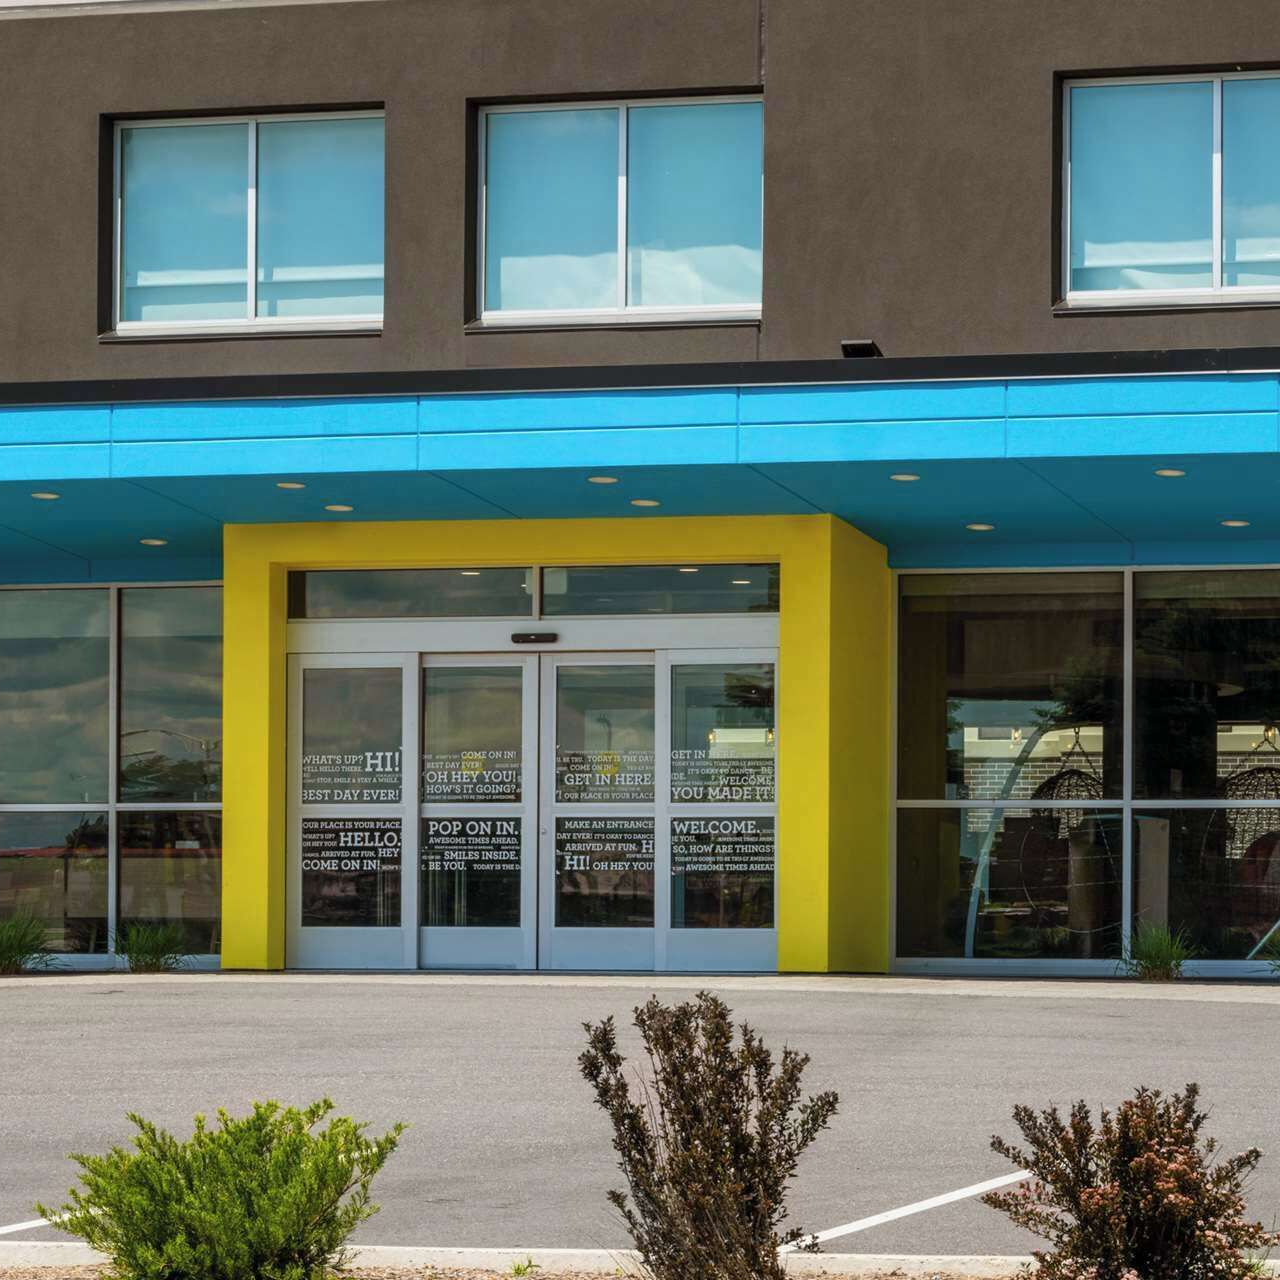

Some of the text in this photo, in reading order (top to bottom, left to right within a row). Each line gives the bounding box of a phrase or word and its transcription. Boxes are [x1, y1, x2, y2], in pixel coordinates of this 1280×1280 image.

[344, 755, 363, 764] UP?
[672, 751, 692, 759] GET
[695, 751, 705, 759] IN
[365, 752, 399, 771] HI!
[427, 771, 448, 782] OH
[452, 771, 479, 782] HEY
[483, 771, 516, 782] YOU!
[565, 774, 655, 784] GET IN HERE.
[427, 785, 516, 793] HOW'S IT GOING?
[672, 787, 774, 799] YOU MADE IT!
[334, 790, 360, 800] DAY
[363, 790, 399, 800] EVER!
[429, 822, 518, 835] POP ON IN.
[673, 821, 760, 833] WELCOME.
[339, 832, 401, 846] HELLO.
[378, 848, 399, 857] HEY
[673, 845, 687, 853] SO,
[690, 845, 713, 853] HOW
[715, 845, 733, 853] ARE
[444, 851, 518, 860] SMILES INSIDE.
[303, 860, 380, 870] COME ON IN!
[429, 862, 441, 870] BE
[443, 862, 466, 870] YOU.
[565, 856, 590, 870] HI!
[593, 862, 608, 870] OH
[610, 862, 630, 870] HEY
